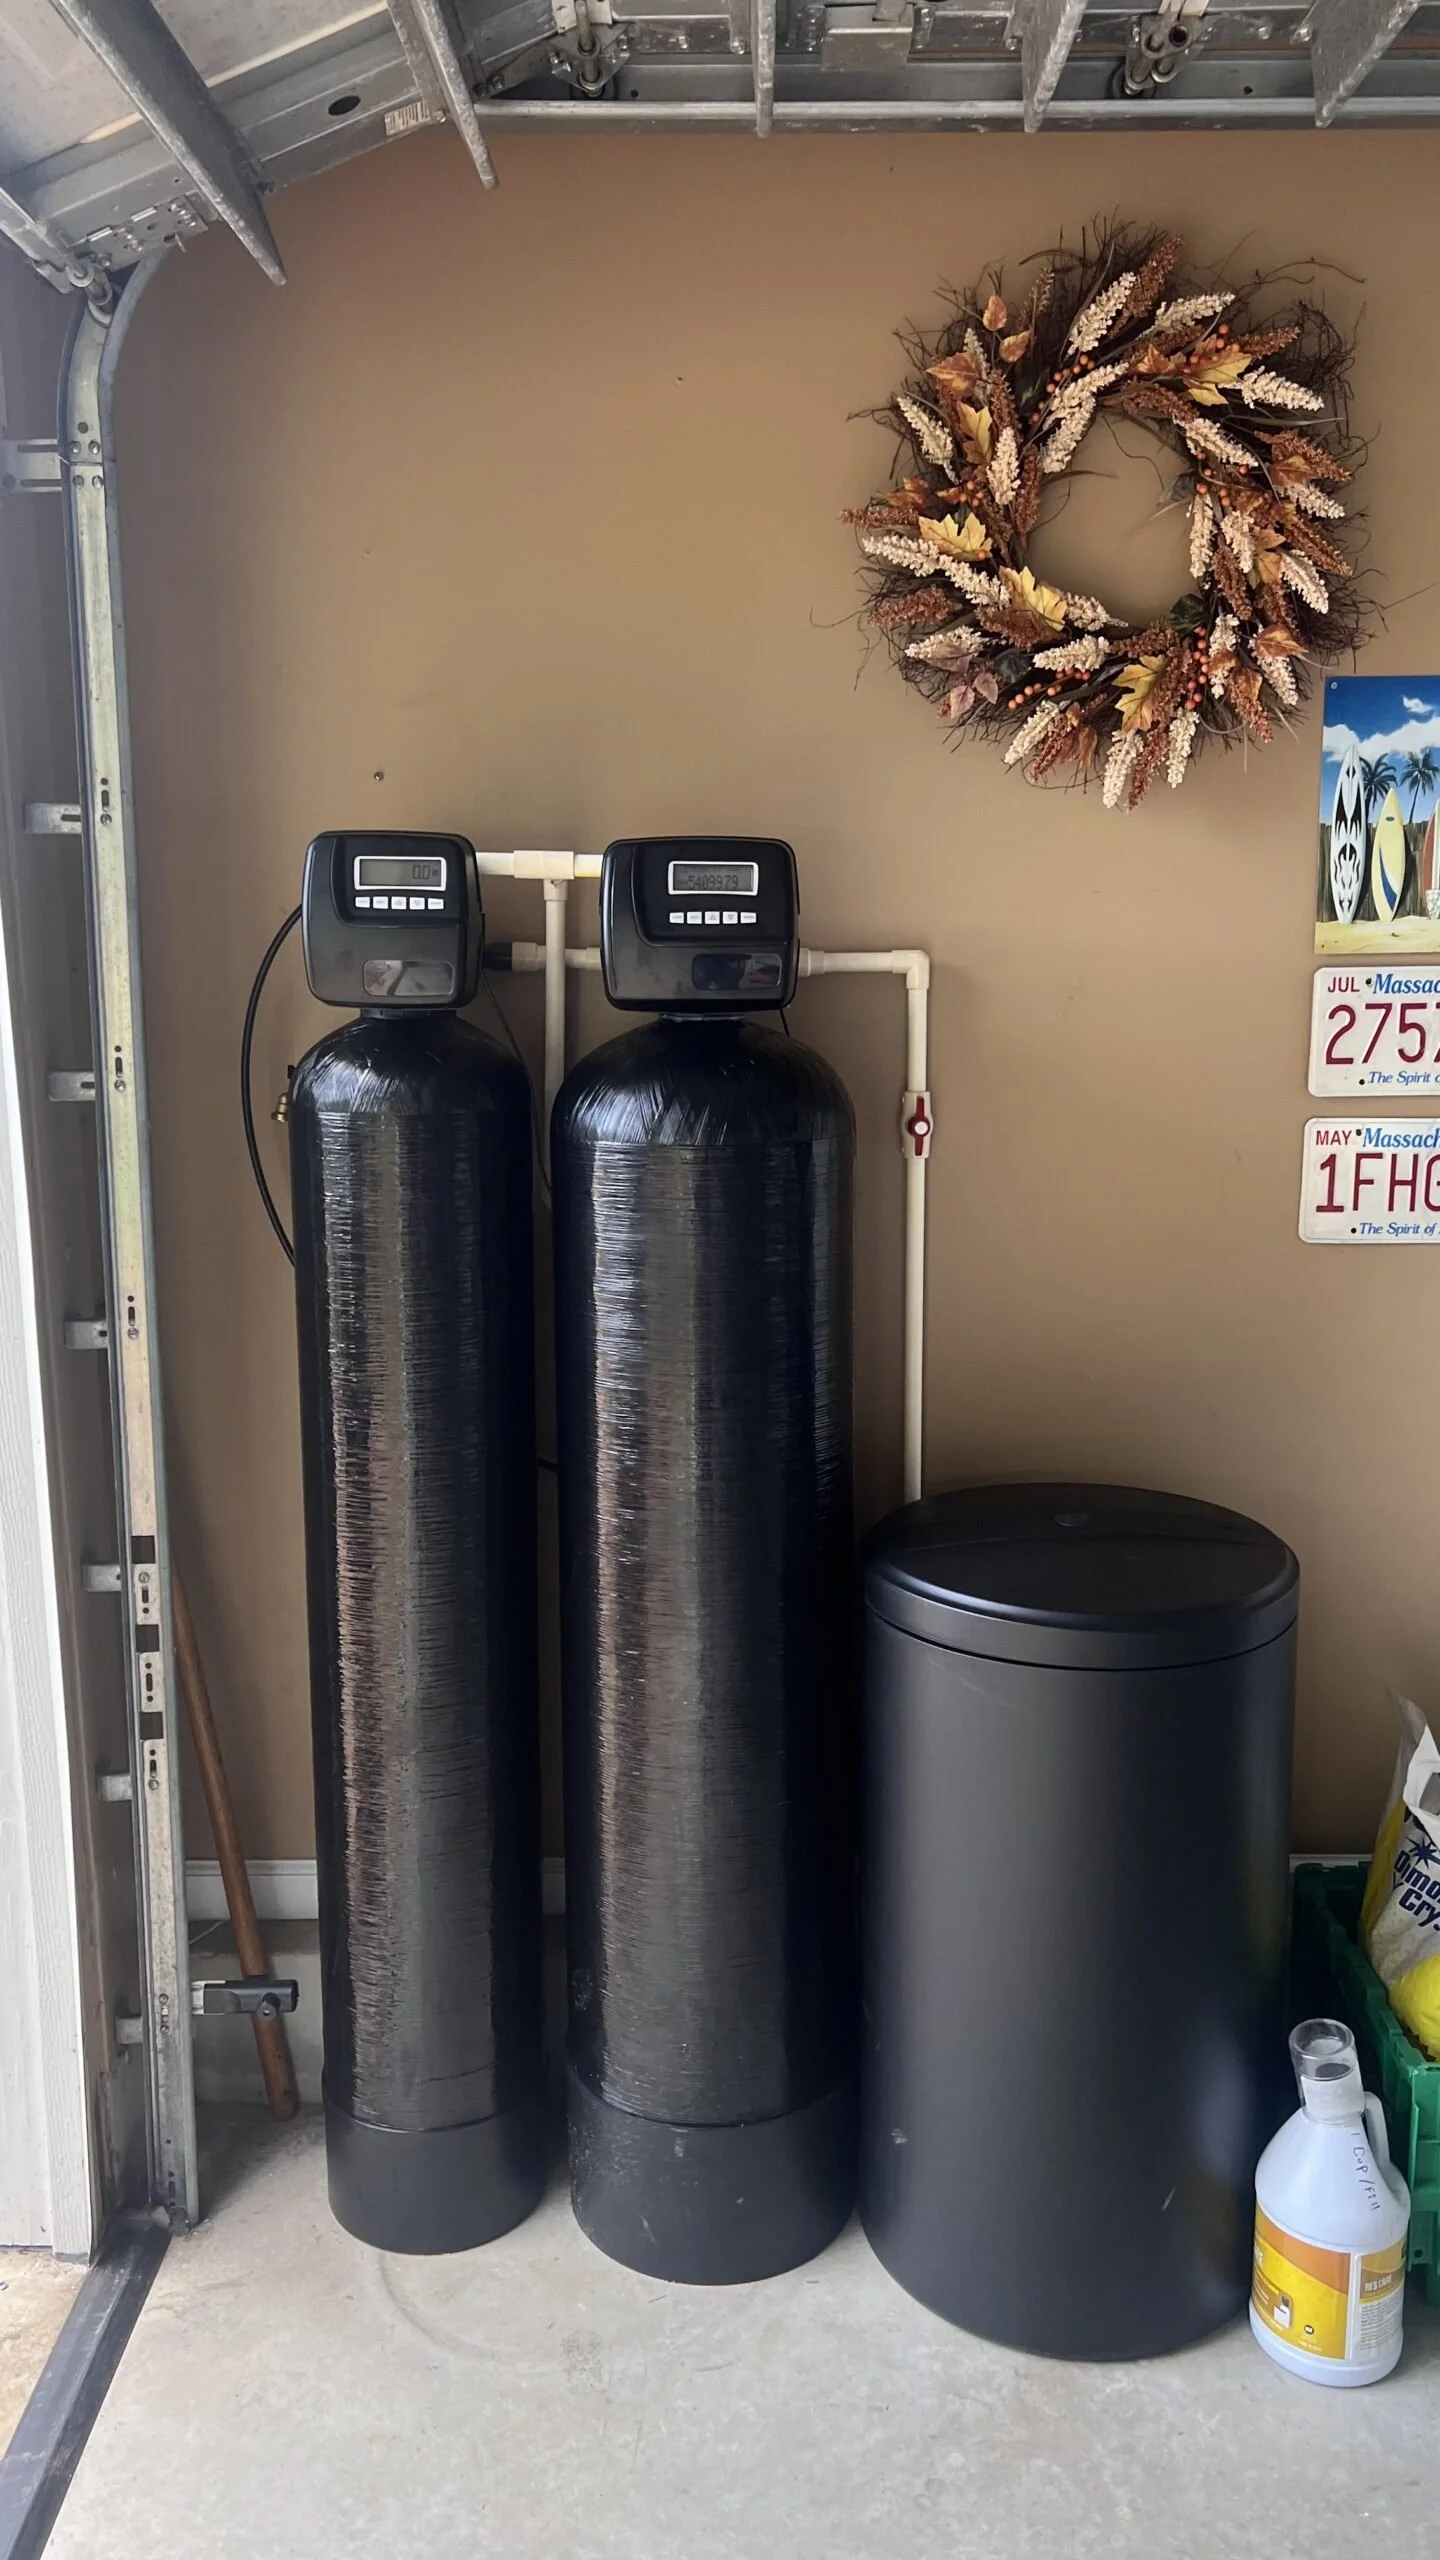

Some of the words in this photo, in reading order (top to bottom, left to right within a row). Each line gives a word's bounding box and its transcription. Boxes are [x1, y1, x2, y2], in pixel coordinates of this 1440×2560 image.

[1328, 976, 1360, 993] JUL
[1325, 1002, 1440, 1065] 275
[1369, 1071, 1394, 1084] The
[1398, 1071, 1431, 1086] Spirit
[1316, 1130, 1352, 1146] MAY
[1360, 1223, 1384, 1235] The
[1386, 1222, 1420, 1237] Spirit
[1424, 1223, 1438, 1237] of
[1364, 2280, 1378, 2292] RES
